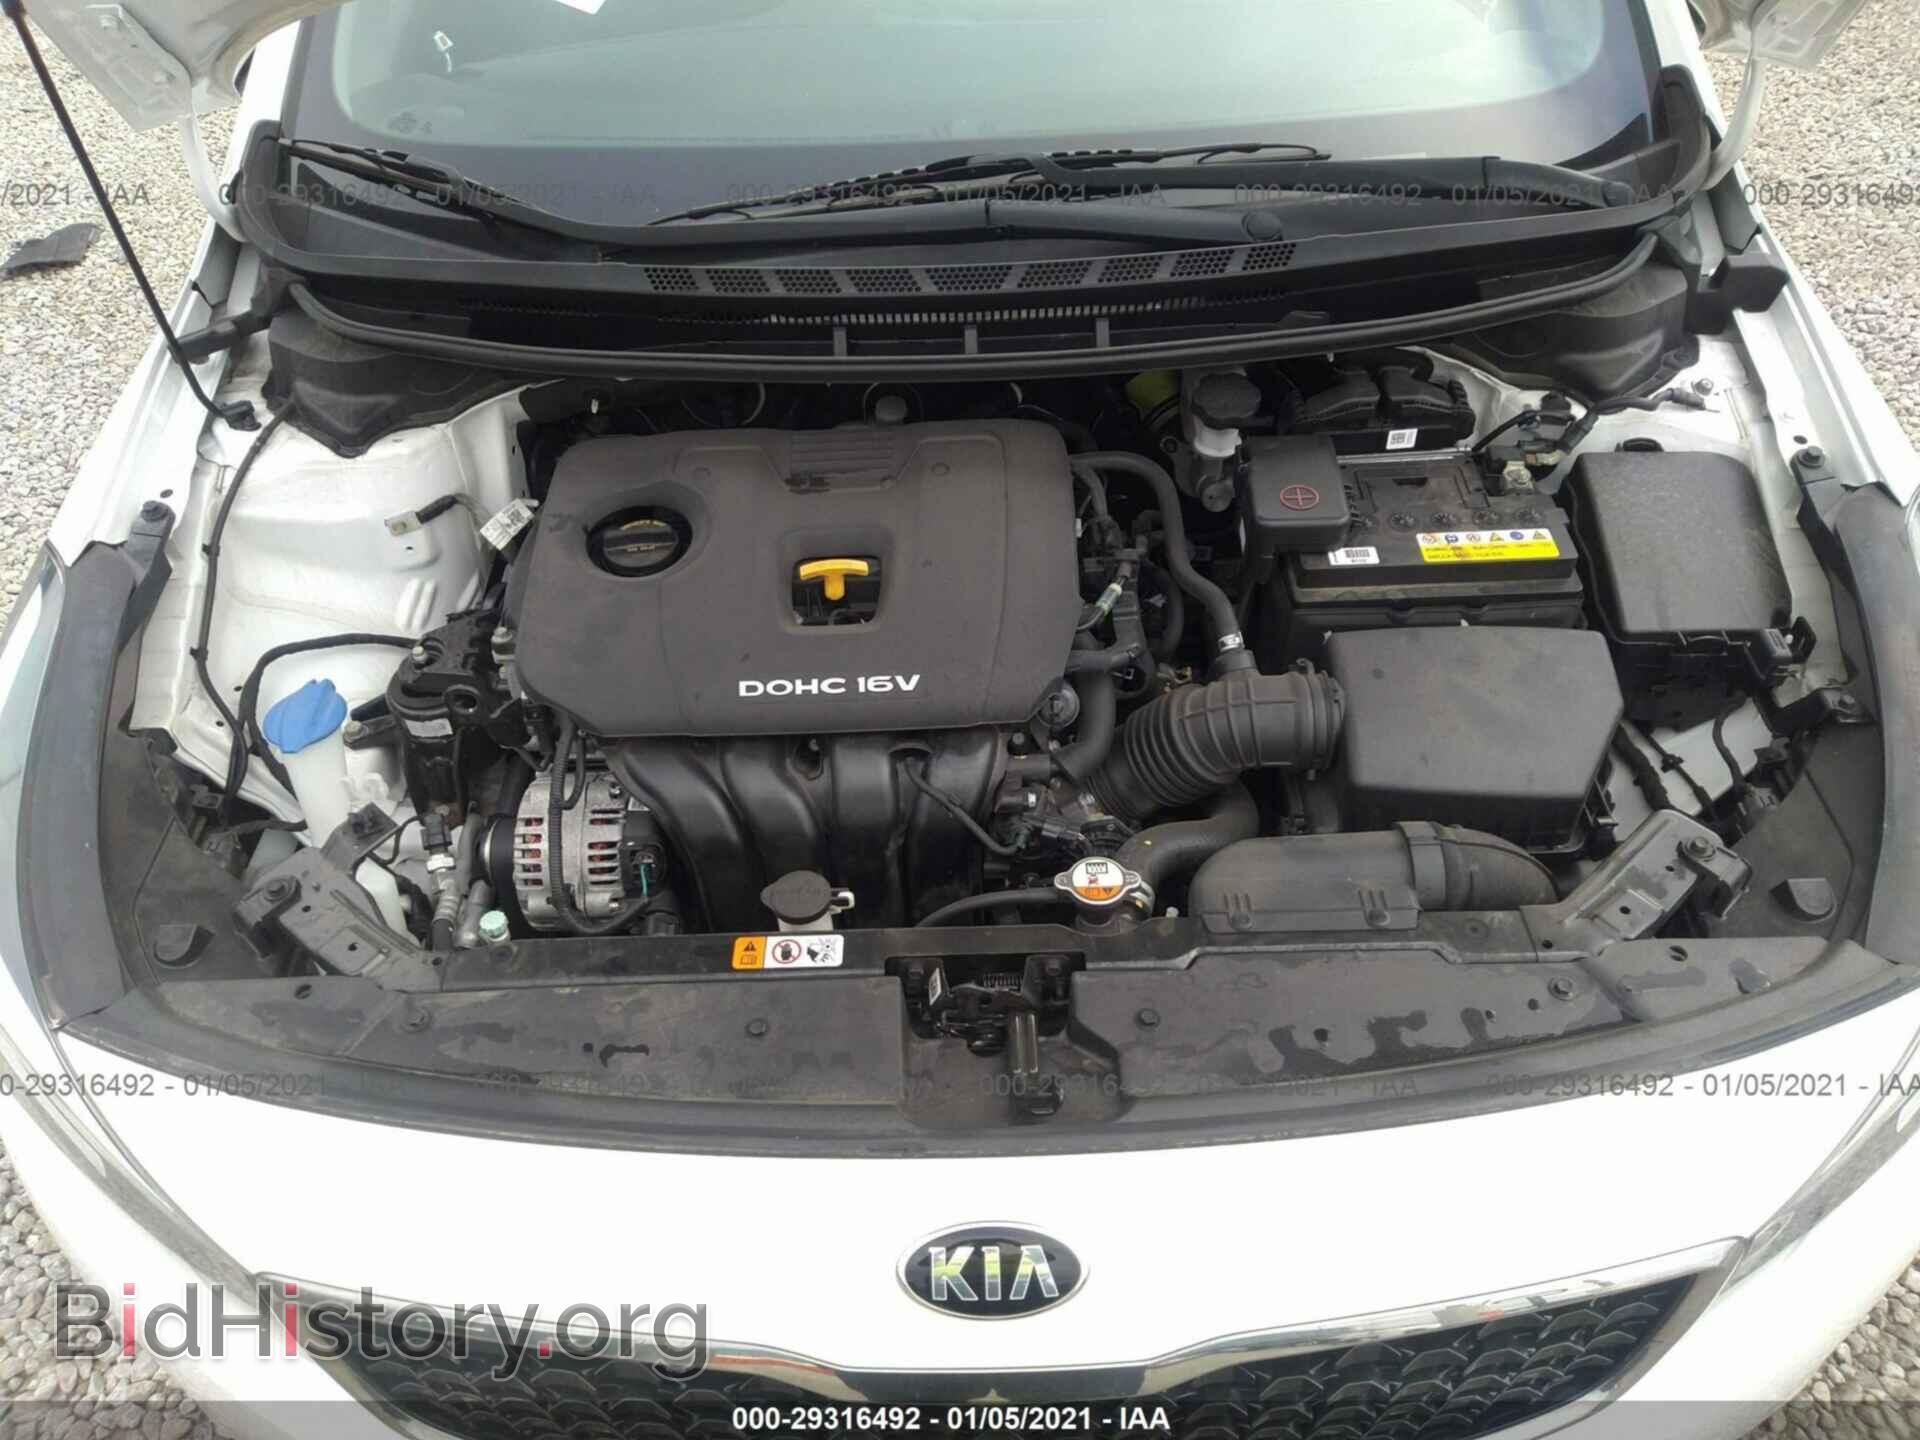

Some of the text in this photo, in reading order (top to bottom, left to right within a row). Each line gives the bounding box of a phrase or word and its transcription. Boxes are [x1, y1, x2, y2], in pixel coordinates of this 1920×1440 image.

[738, 674, 921, 697] DOHC 16V
[928, 1245, 1059, 1301] KIA
